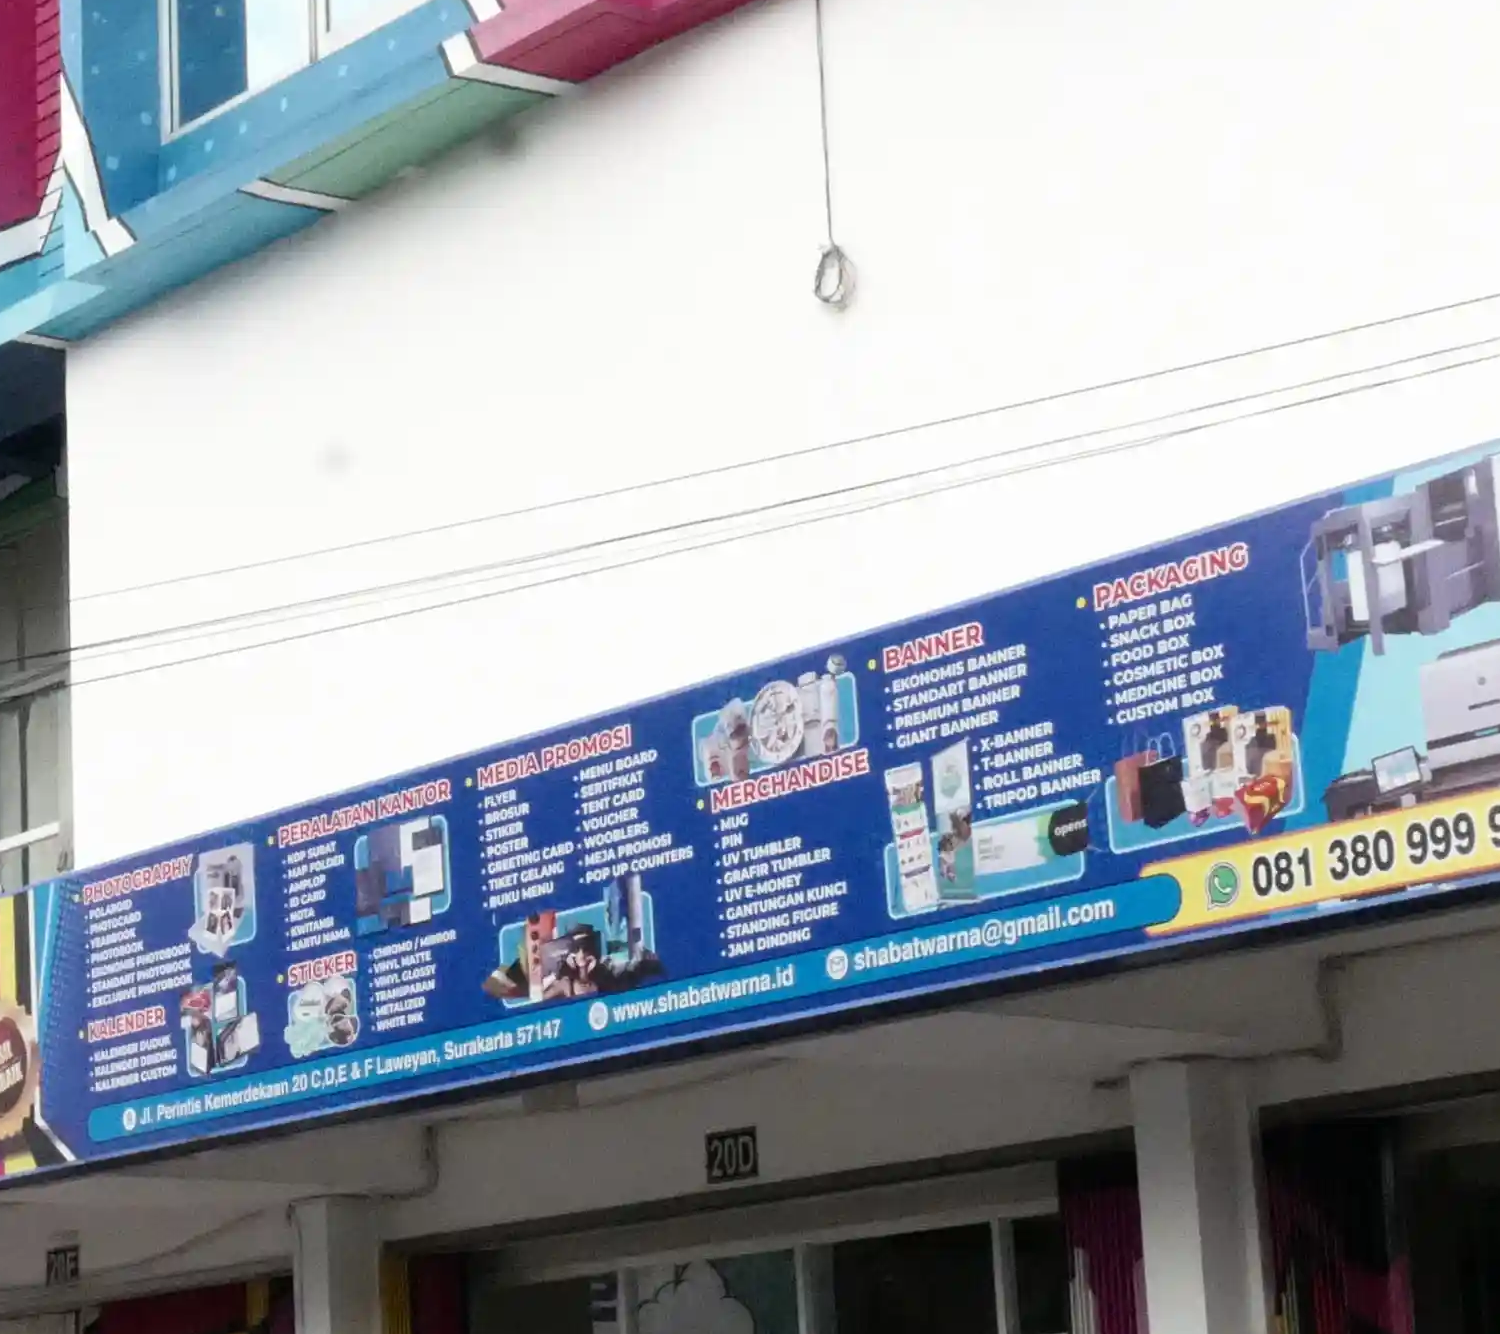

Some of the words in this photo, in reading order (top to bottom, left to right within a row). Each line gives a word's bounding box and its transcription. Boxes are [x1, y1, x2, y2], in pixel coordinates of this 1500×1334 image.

[1093, 541, 1249, 612] PACKAGING
[1107, 607, 1157, 631] PAPER
[1160, 594, 1192, 614] BAG
[1110, 627, 1160, 649] SNACK
[1163, 612, 1196, 632] BOX
[883, 621, 985, 673] BANNER
[1110, 647, 1154, 667] FOOD
[1157, 633, 1191, 654] BOX
[1112, 653, 1189, 686] COSMETIC
[1192, 644, 1225, 665] BOX
[892, 661, 965, 693] EKONOMIS
[967, 643, 1026, 671] BANNER
[1114, 676, 1188, 706] MEDICINE
[1191, 665, 1224, 686] BOX
[893, 680, 965, 713] STANDART
[968, 663, 1028, 691] BANNER
[1117, 697, 1179, 724] CUSTOM
[1182, 688, 1216, 707] BOX
[896, 726, 939, 749] GIANT
[940, 710, 999, 736] BANNER
[980, 721, 1053, 753] X-BANNER
[476, 753, 540, 790] MEDIA
[541, 724, 632, 771] PROMOSI
[580, 759, 613, 781] MENU
[616, 749, 657, 772] BOARD
[981, 741, 1053, 772] T-BANNER
[983, 771, 1020, 791] ROLL
[1022, 753, 1084, 780] BANNER
[580, 770, 644, 799] SERTIFIKAT
[710, 748, 870, 813] MERCHANDISE
[984, 786, 1038, 810] TRIPOD
[1040, 769, 1101, 793] BANNER
[278, 799, 378, 849] PERALATAN
[378, 779, 451, 819] KANTOR
[581, 794, 611, 815] TENT
[612, 788, 645, 806] CARD
[582, 807, 639, 832] VOUCHER
[720, 813, 749, 833] MUG
[721, 834, 742, 850] PIN
[585, 868, 611, 884] POP
[612, 863, 630, 876] UP
[631, 846, 694, 871] COUNTERS
[722, 852, 740, 867] UV
[740, 837, 802, 864] TUMBLER
[724, 863, 768, 886] GRAFIR
[770, 848, 831, 875] TUMBLER
[1251, 847, 1313, 899] 081
[1328, 829, 1395, 879] 380
[1406, 810, 1477, 862] 999
[83, 854, 194, 905] PHOTOGRAPHY
[726, 895, 806, 921] GANTUNGAN
[806, 882, 848, 905] KUNCI
[726, 915, 792, 939] STANDING
[792, 903, 839, 925] FIGURE
[854, 898, 1115, 972] shabatwarna@gmail.com
[728, 938, 756, 957] JAM
[756, 927, 812, 951] DINDING
[288, 950, 357, 987] STICKER
[612, 965, 795, 1023] www.shabatwarna.id
[88, 1005, 166, 1043] KALENDER
[156, 1100, 202, 1121] Perintis
[205, 1079, 289, 1111] Kemerdekaan
[291, 1074, 308, 1093] 20
[351, 1062, 361, 1079] &
[364, 1058, 374, 1076] F
[376, 1048, 440, 1077] Laweyan,
[444, 1031, 513, 1061] Surakarta
[516, 1019, 561, 1043] 57147
[711, 1136, 753, 1177] 20D
